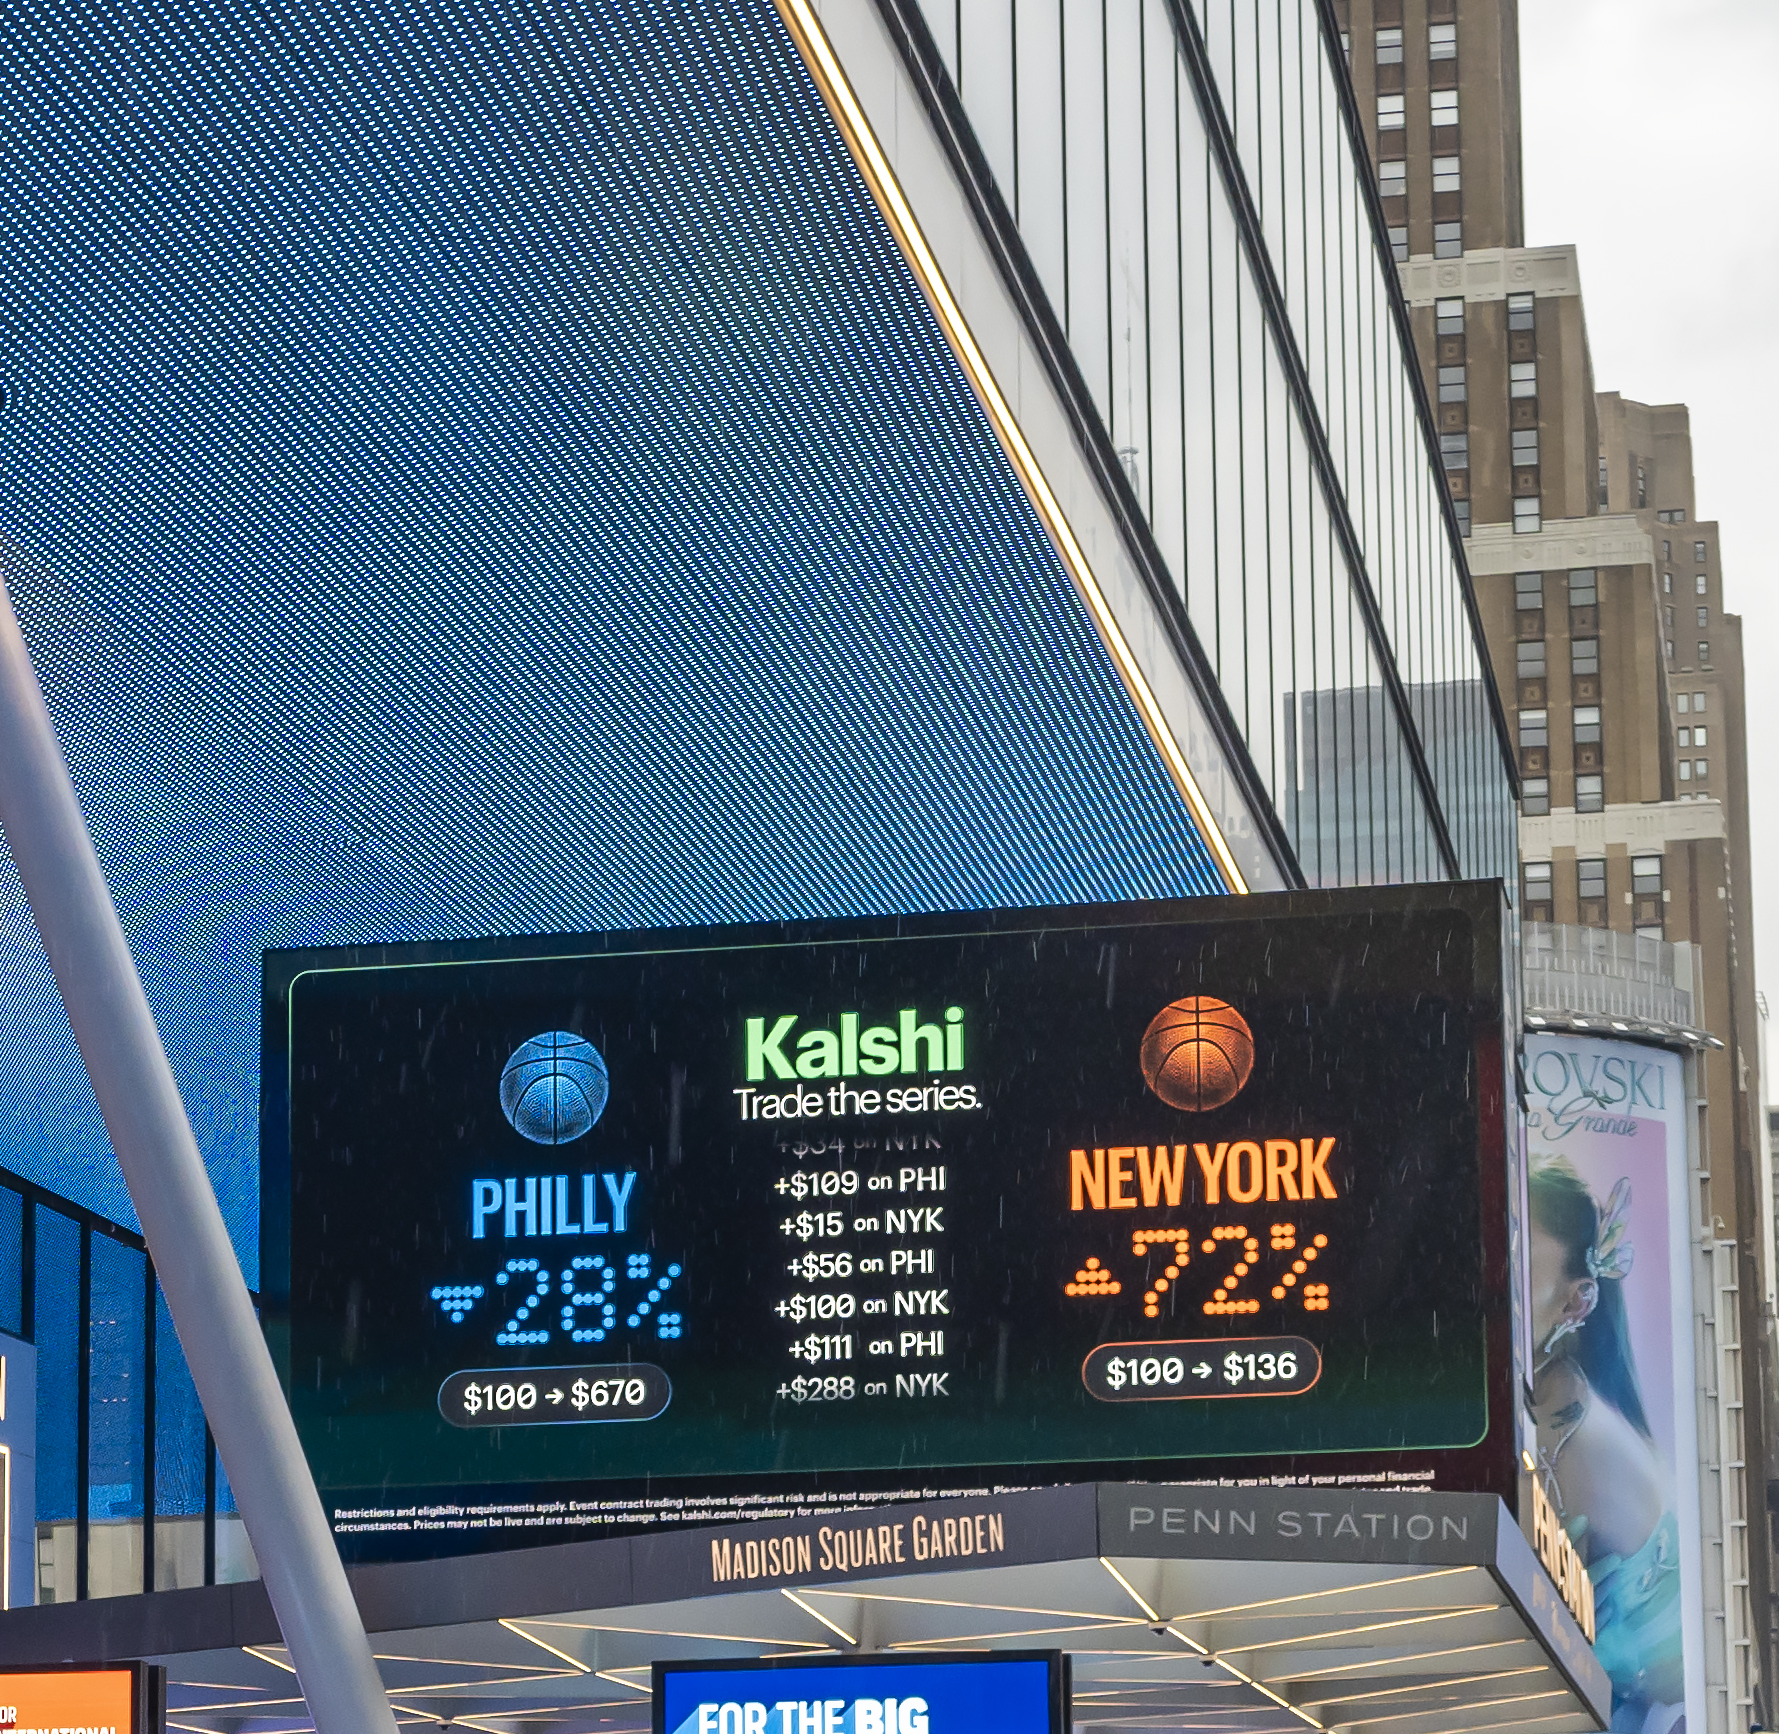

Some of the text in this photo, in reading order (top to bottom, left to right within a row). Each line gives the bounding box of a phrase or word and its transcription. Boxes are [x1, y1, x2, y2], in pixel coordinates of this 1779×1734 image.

[746, 1006, 964, 1081] Kalshi
[733, 1079, 983, 1120] Trade the series.
[774, 1166, 946, 1201] +$109 on PHI
[1069, 1136, 1338, 1211] NEW YORK
[471, 1171, 637, 1240] PHILLY
[780, 1207, 944, 1242] +$15 on NYK
[787, 1248, 934, 1282] +$56 on PHI
[1132, 1223, 1329, 1318] 72%
[496, 1253, 683, 1346] 28%
[774, 1289, 949, 1324] +$100 on NYK
[789, 1330, 944, 1365] +$111 on PHI
[777, 1372, 949, 1404] +$288 on NYK
[1106, 1352, 1298, 1389] $100 $136
[463, 1377, 646, 1415] $100 $670
[334, 1508, 394, 1519] Restrictions
[396, 1507, 416, 1517] and
[418, 1505, 464, 1518] eligibility
[467, 1503, 535, 1515] requirements
[537, 1502, 568, 1514] apply.
[570, 1501, 598, 1511] Event
[600, 1499, 644, 1510] contract
[646, 1497, 683, 1509] trading
[685, 1496, 728, 1506] involves
[729, 1493, 784, 1506] significant
[786, 1493, 805, 1503] risk
[807, 1492, 826, 1502] and
[829, 1492, 837, 1501] is
[839, 1491, 857, 1501] not
[859, 1489, 920, 1501] appropriate
[922, 1487, 938, 1498] for
[1298, 1474, 1309, 1485] of
[1337, 1472, 1386, 1485] personal
[1387, 1470, 1435, 1481] financial
[335, 1521, 411, 1532] circumstances.
[414, 1519, 445, 1530] Prices
[447, 1520, 468, 1531] may
[470, 1518, 487, 1528] not
[489, 1517, 502, 1527] be
[505, 1517, 522, 1526] live
[524, 1516, 543, 1526] and
[545, 1516, 562, 1525] are
[565, 1514, 602, 1526] subject
[604, 1514, 615, 1523] to
[617, 1511, 658, 1522] change.
[660, 1510, 679, 1521] See
[797, 1506, 811, 1516] for
[1129, 1507, 1468, 1540] PENN STATION
[711, 1513, 1005, 1584] MADISON SQUARE GARDEN
